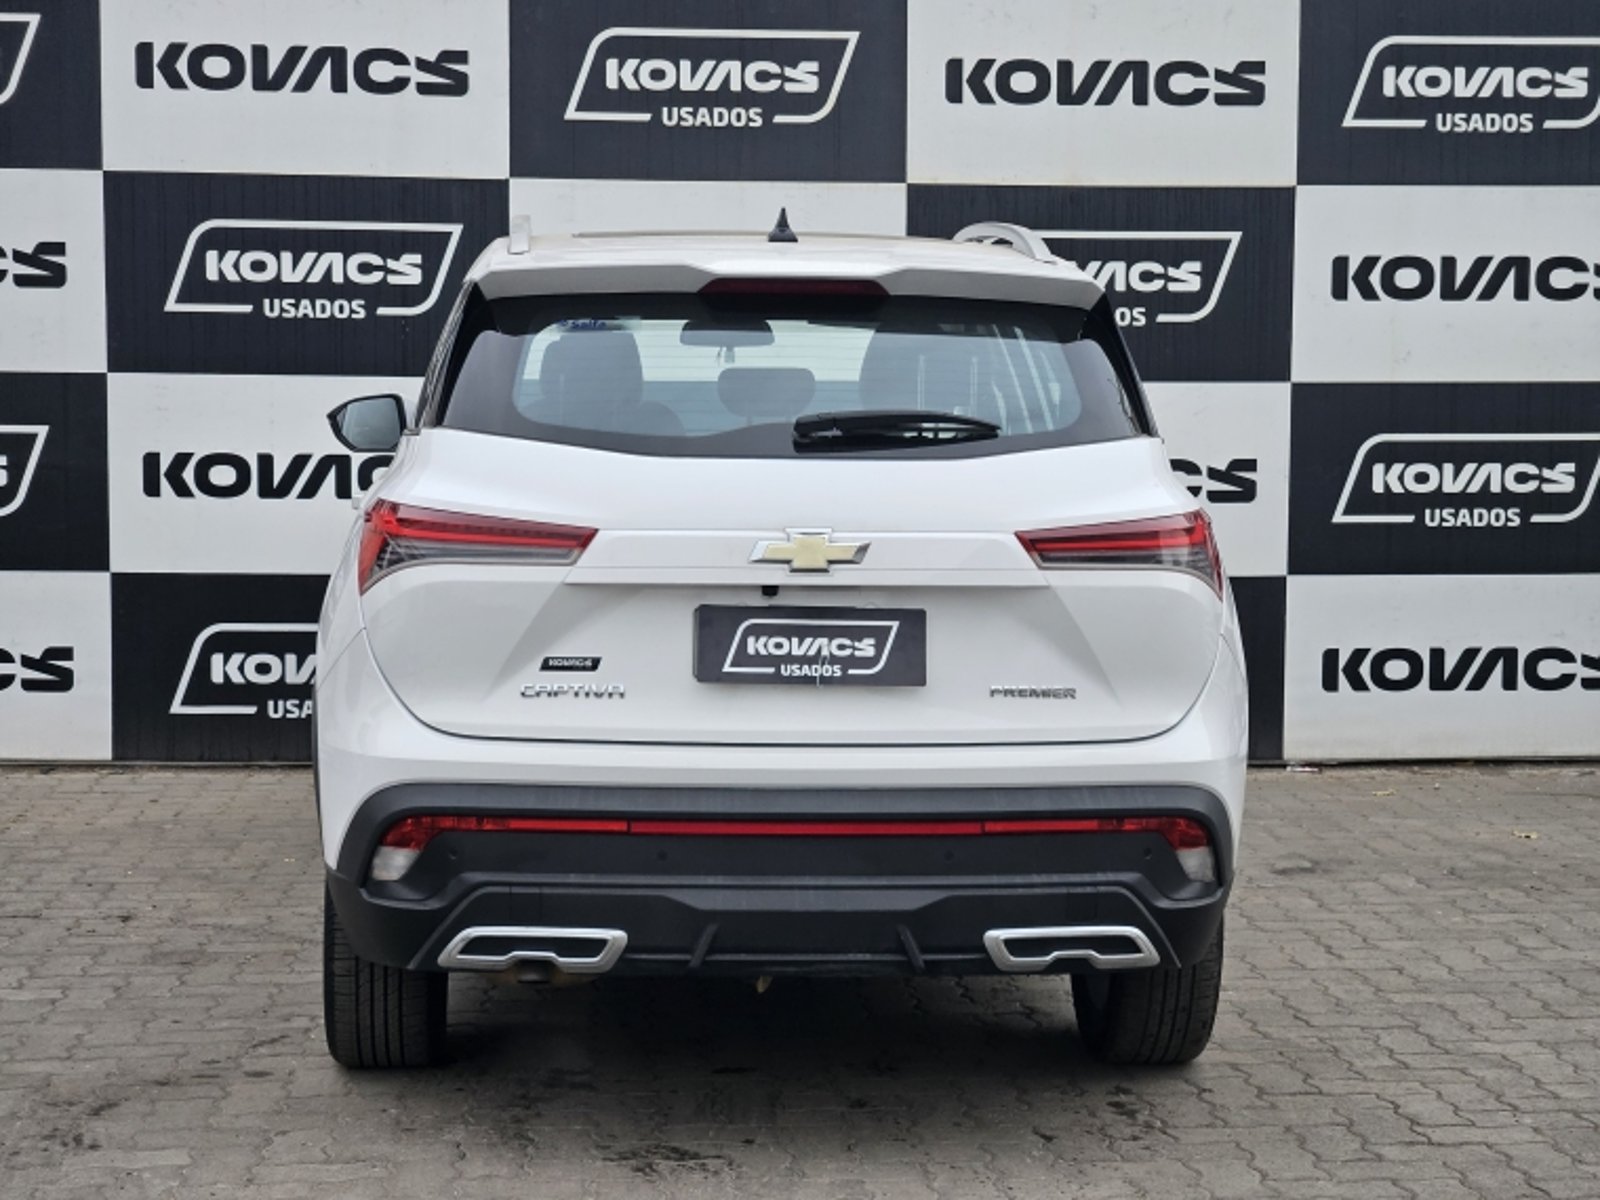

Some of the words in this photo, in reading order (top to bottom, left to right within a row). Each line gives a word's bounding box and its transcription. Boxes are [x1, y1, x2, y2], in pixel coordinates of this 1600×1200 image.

[135, 42, 469, 97] KOVACS
[605, 59, 820, 92] KOVACS
[945, 58, 1266, 106] KOVACS
[1382, 65, 1588, 98] KOVACS
[661, 106, 763, 128] USADOS
[1436, 112, 1534, 133] USADOS
[205, 249, 423, 285] KOVACS
[1331, 255, 1600, 301] KOVAC
[263, 298, 366, 319] USADOS
[1371, 462, 1575, 494] KOVACS
[1424, 507, 1521, 527] USADOS
[746, 635, 876, 657] KOVACS
[780, 663, 843, 677] USADOS
[520, 683, 625, 699] CAPTIVA
[989, 686, 1077, 700] PREMIER
